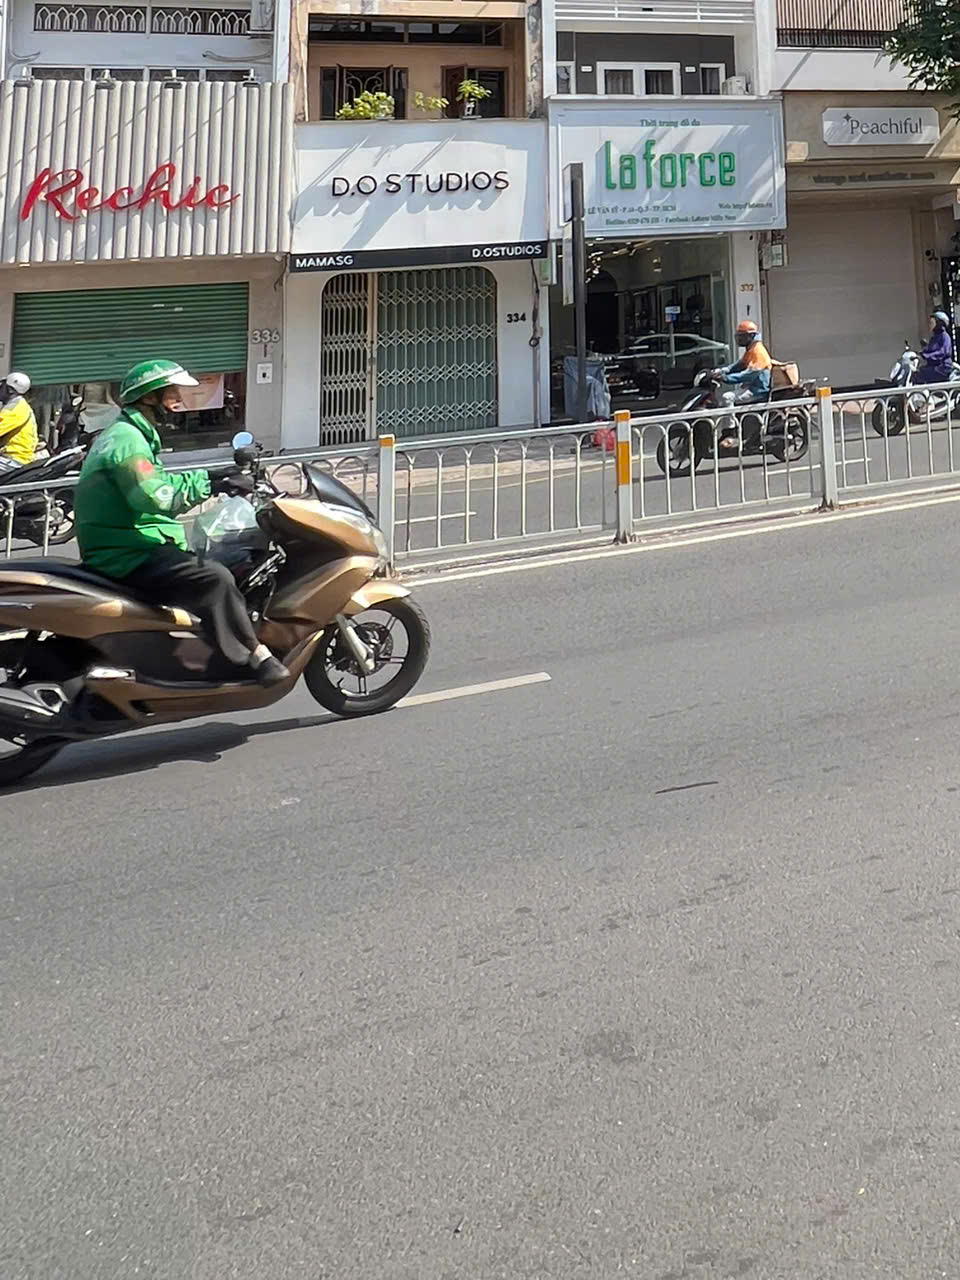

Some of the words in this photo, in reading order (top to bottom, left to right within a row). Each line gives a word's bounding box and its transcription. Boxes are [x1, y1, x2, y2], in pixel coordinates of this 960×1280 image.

[849, 117, 923, 135] Peachiful
[331, 175, 377, 198] D.O
[385, 170, 510, 195] STUDIOS
[19, 163, 241, 222] Rechic
[295, 254, 354, 268] MAMASG
[506, 312, 527, 324] 334
[251, 328, 281, 343] 336
